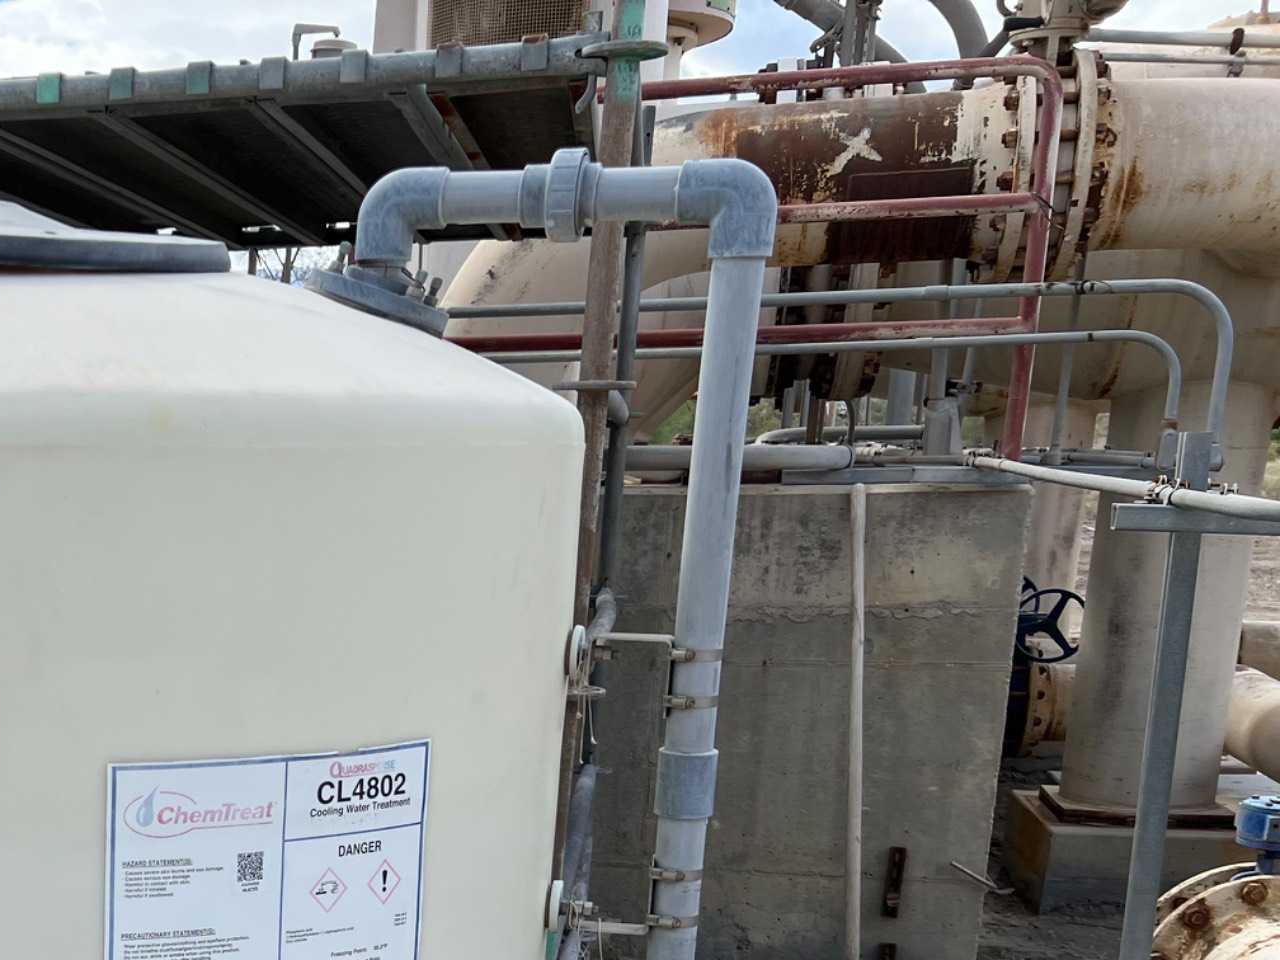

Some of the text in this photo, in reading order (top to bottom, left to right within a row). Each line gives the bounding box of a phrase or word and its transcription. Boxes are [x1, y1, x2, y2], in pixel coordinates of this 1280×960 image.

[317, 772, 406, 805] CL4802
[157, 801, 273, 825] ChemTreat
[310, 797, 411, 818] Cooling Water Treatment
[338, 840, 382, 857] DANGER
